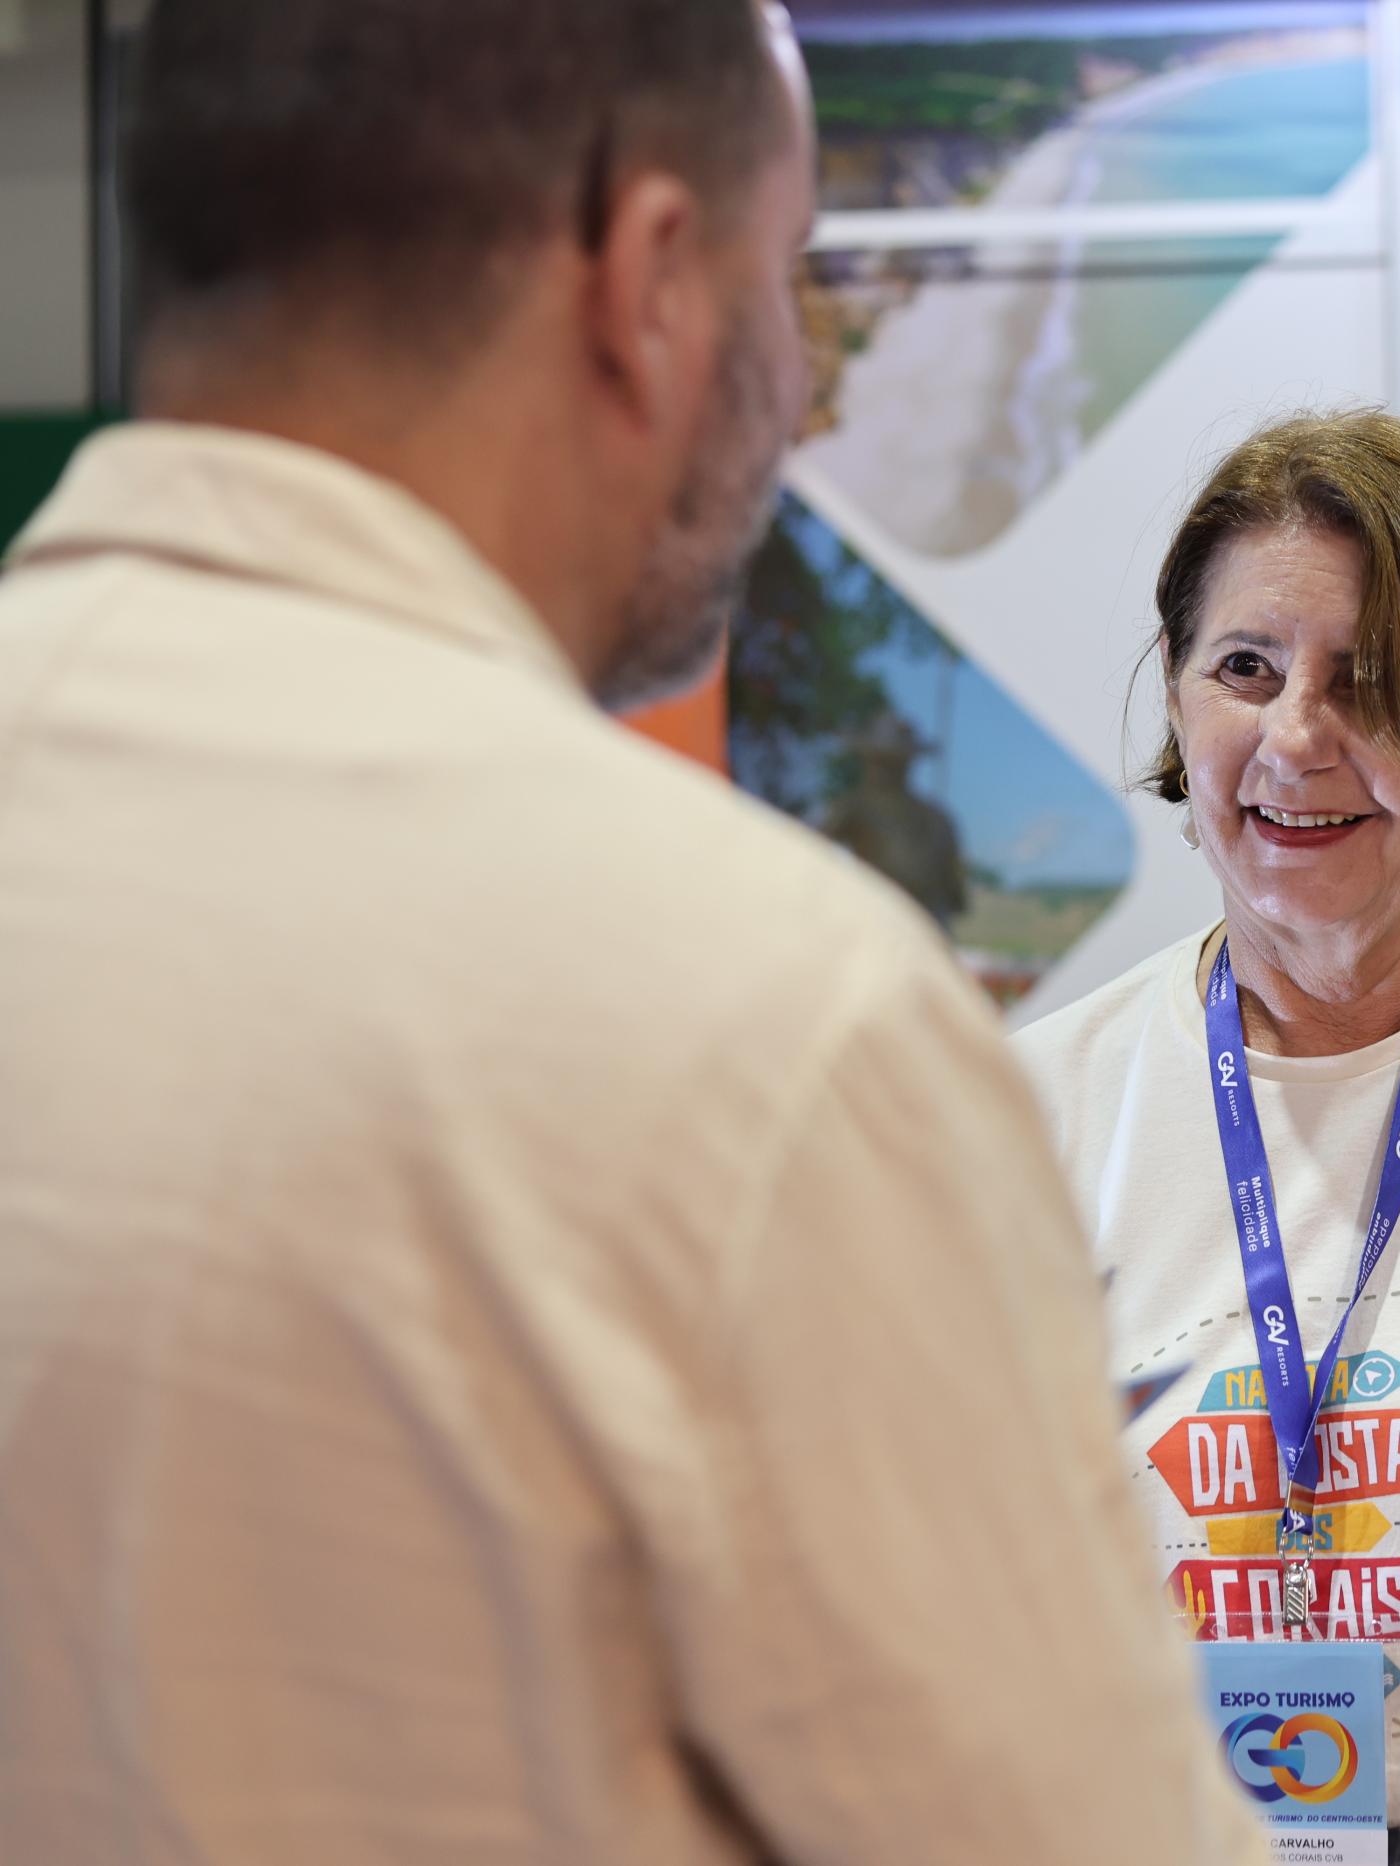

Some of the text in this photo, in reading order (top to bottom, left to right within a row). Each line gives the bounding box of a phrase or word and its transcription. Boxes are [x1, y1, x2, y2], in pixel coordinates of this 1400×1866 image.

[1217, 1051, 1240, 1127] GAV RESORTS
[1236, 1181, 1258, 1252] felicidade
[1251, 1176, 1271, 1248] Multiplique
[1263, 1305, 1289, 1387] GAV RESORTS
[1188, 1423, 1257, 1507] DA
[1220, 1692, 1355, 1708] EXPO TURISMO
[1268, 1815, 1303, 1823] TURISMO
[1307, 1815, 1319, 1823] DO
[1321, 1815, 1383, 1823] CENTRO-OESTE
[1270, 1838, 1335, 1849] CARVALHO
[1288, 1853, 1323, 1863] CORAIS
[1325, 1854, 1344, 1863] CVB
